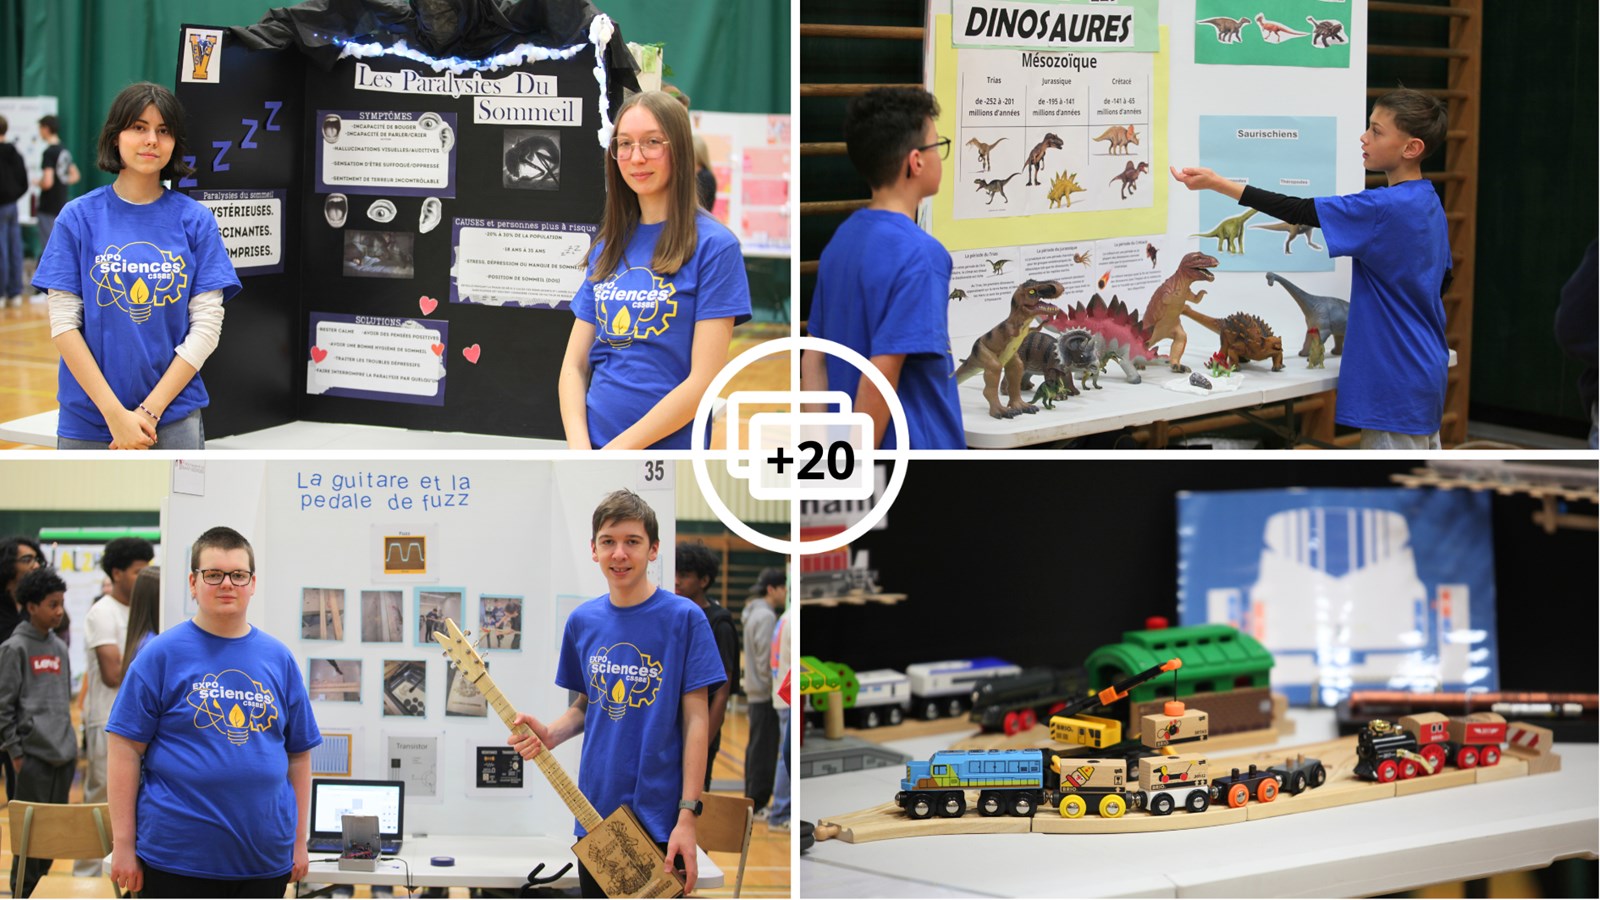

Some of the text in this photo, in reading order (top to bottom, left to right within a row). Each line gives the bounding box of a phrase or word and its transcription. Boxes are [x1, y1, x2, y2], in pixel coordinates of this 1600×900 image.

[965, 6, 1132, 43] DINOSAURES
[1022, 52, 1097, 72] Mésozoïque
[358, 66, 548, 98] Les Paralysies Du
[1112, 77, 1132, 85] Crétacé
[359, 111, 412, 119] SYMPTÔMES
[479, 100, 574, 122] Sommeil
[1238, 130, 1297, 138] Saurischiens
[204, 191, 274, 200] Paralysies du sommeil
[209, 202, 273, 217] YSTÉRIEUSES.
[455, 218, 484, 226] CAUSES
[497, 221, 538, 229] personnes
[542, 222, 559, 231] plus
[569, 225, 596, 233] risque
[95, 254, 121, 263] EXPO
[100, 259, 180, 273] sciences
[595, 287, 669, 301] sciences
[356, 316, 401, 326] SOLUTIONS
[391, 359, 420, 367] DÉPRESSIFS
[645, 461, 664, 481] 35
[297, 472, 471, 491] La guitare et la
[301, 493, 469, 511] pedale de fuzz
[591, 661, 658, 677] sciences
[193, 681, 218, 690] EXPO
[626, 675, 647, 683] CSSBE
[199, 686, 271, 704] sciences
